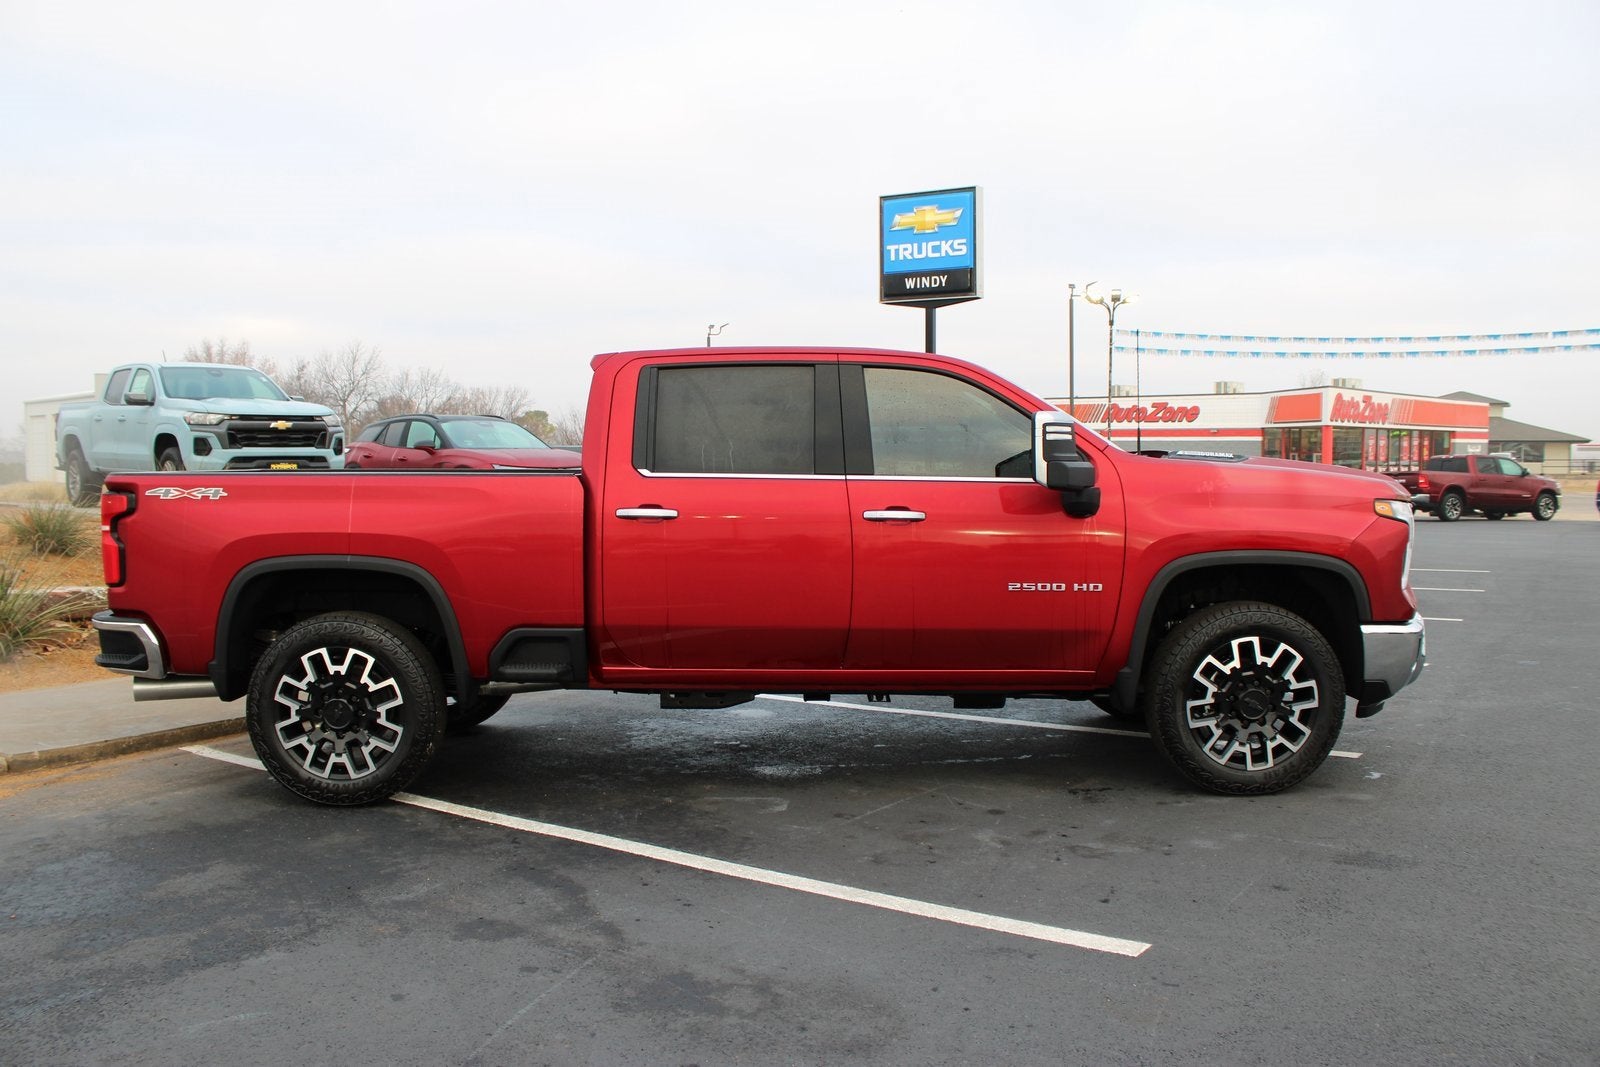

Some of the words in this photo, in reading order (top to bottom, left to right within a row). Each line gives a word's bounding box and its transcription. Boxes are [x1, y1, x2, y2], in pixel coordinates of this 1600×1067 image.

[886, 238, 968, 261] TRUCKS
[905, 275, 948, 289] WINDY
[1101, 402, 1200, 423] AutoZone
[1330, 392, 1389, 425] AutoZone
[1008, 582, 1066, 591] 2500
[1073, 583, 1103, 592] HD
